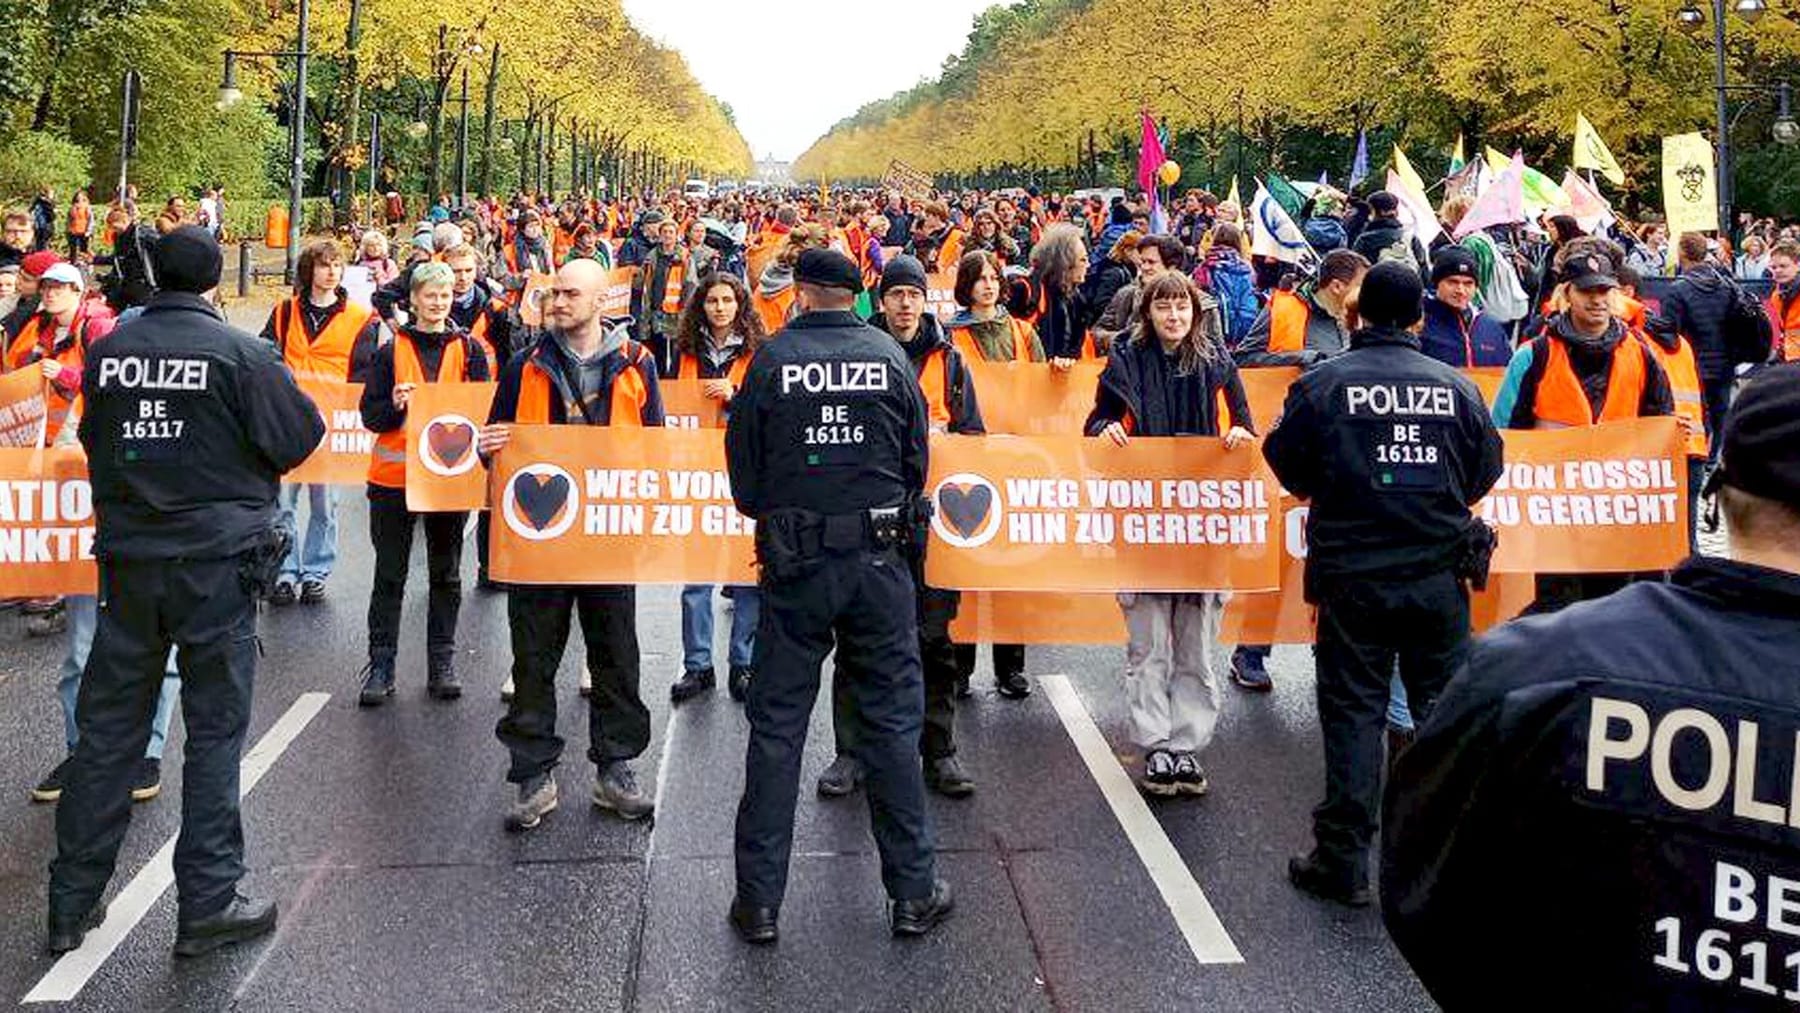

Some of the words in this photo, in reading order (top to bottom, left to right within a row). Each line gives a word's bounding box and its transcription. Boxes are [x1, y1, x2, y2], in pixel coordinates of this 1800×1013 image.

[99, 356, 209, 391] POLIZEI
[782, 362, 888, 394] POLIZEI
[140, 400, 167, 418] BE
[821, 405, 849, 423] BE
[1347, 385, 1455, 416] POLIZEI
[122, 420, 184, 438] 16117
[331, 432, 372, 454] HIN
[804, 426, 864, 444] 16116
[1393, 424, 1421, 442] BE
[1377, 445, 1437, 463] 16118
[584, 469, 660, 499] WEG
[667, 470, 734, 500] VON
[1563, 459, 1677, 490] FOSSIL
[1007, 480, 1080, 508] WEG
[1086, 480, 1153, 508] VON
[1161, 480, 1269, 508] FOSSIL
[1527, 493, 1678, 526] GERECHT
[584, 504, 643, 536] HIN
[651, 504, 693, 536] ZU
[1008, 513, 1067, 543] HIN
[1075, 513, 1115, 544] ZU
[1123, 513, 1269, 544] GERECHT
[1714, 861, 1800, 936] BE
